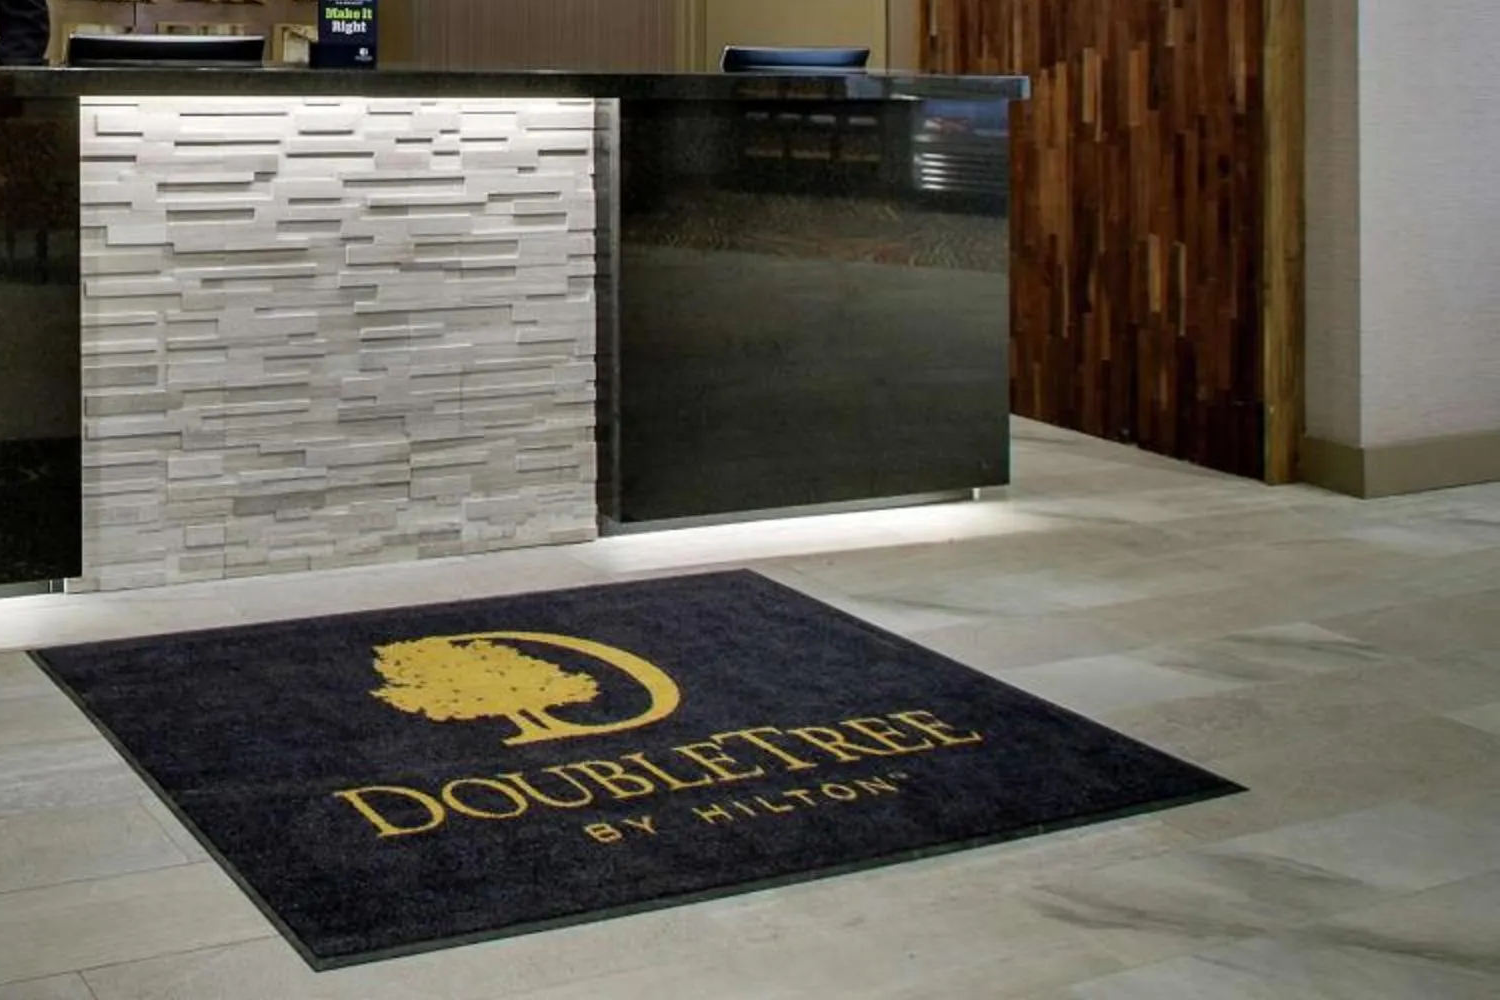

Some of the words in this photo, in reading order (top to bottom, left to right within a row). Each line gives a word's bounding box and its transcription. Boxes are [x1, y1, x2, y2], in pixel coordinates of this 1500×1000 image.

[325, 7, 360, 19] Make
[332, 20, 367, 35] Right
[583, 814, 658, 843] BY
[691, 774, 899, 825] HILTON
